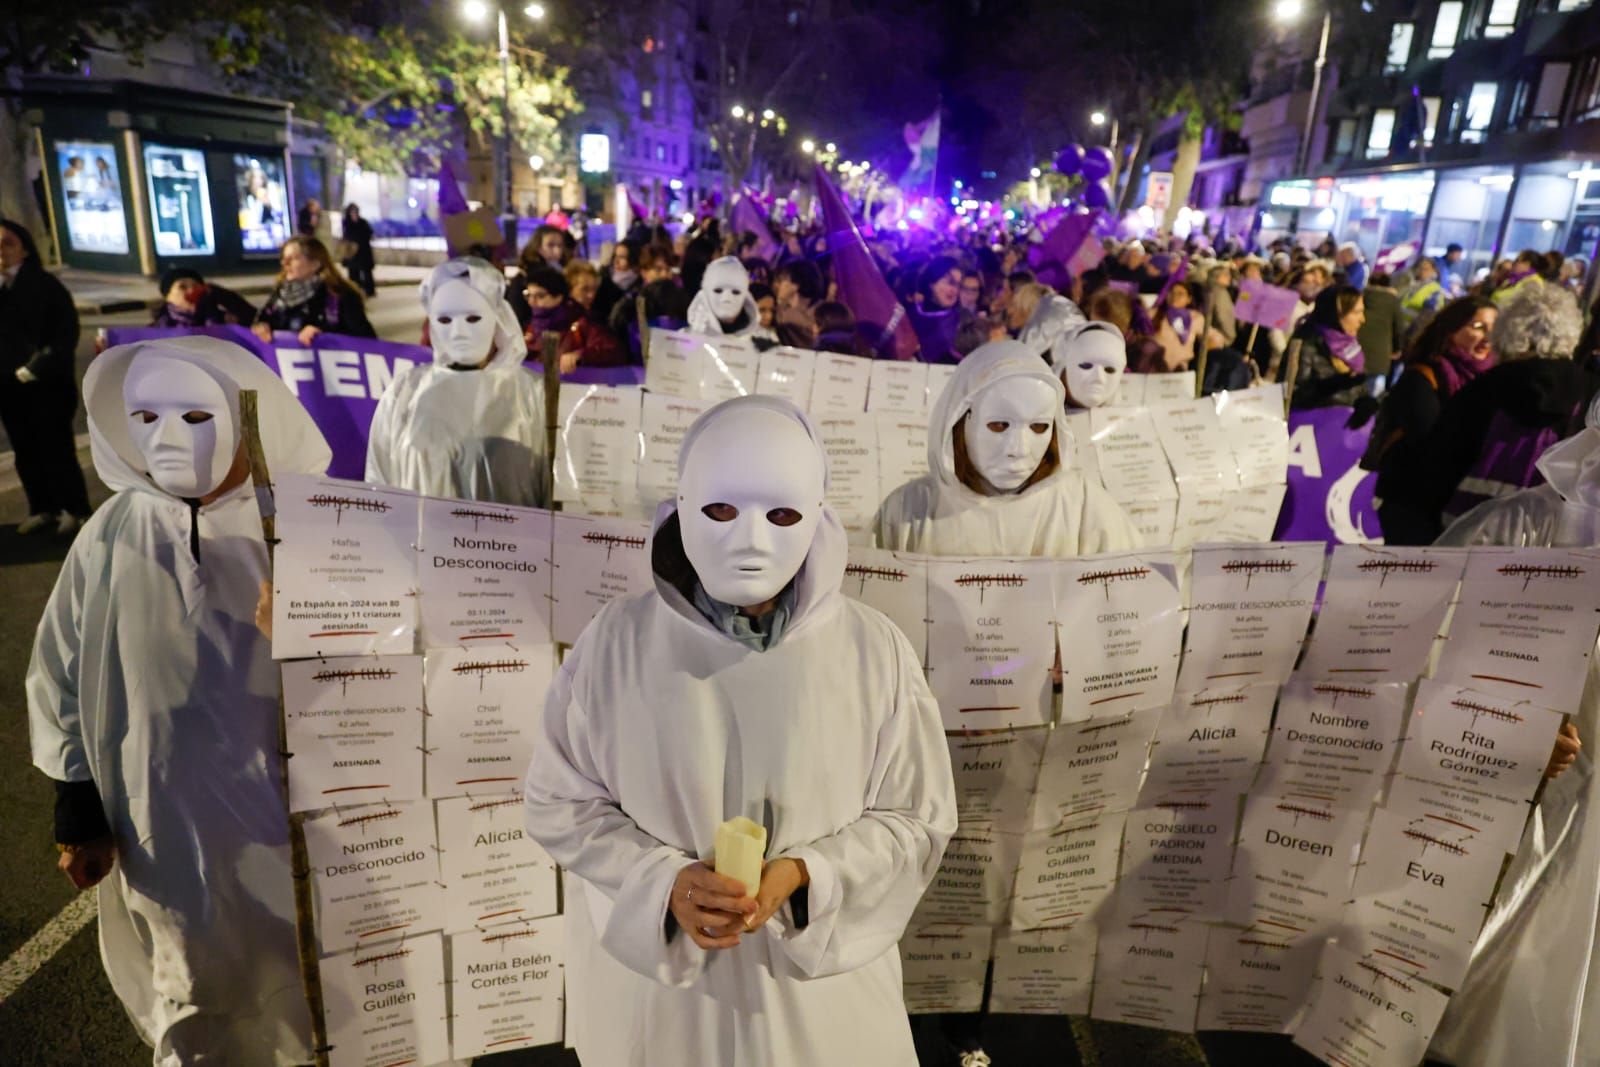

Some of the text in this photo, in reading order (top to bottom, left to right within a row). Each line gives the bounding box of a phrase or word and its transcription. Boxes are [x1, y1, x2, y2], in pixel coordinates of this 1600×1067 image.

[275, 348, 422, 401] FEM
[453, 536, 518, 553] Nombre
[433, 556, 537, 574] Desconocido
[1225, 559, 1292, 574] SOMOS ELLAS
[1361, 559, 1433, 573] SOMOS ELLAS
[1502, 563, 1579, 579] SOMOS ELLAS
[959, 573, 1023, 588] SOMOS ELLAS
[1081, 566, 1147, 586] SOMOS ELLAS
[291, 601, 301, 609] En
[304, 600, 335, 610] España
[350, 600, 370, 608] 2024
[1197, 599, 1306, 610] NOMBRE DESCONOCIDO
[1480, 600, 1509, 609] Mujer
[287, 611, 342, 620] feminicidios
[976, 617, 1002, 626] CLOE
[1096, 611, 1139, 624] CRISTIAN
[321, 621, 369, 630] asesinadas
[1488, 649, 1540, 662] ASESINADA
[970, 678, 1014, 686] ASESINADA
[1084, 671, 1123, 683] VIOLENCIA
[1124, 666, 1152, 677] VICARIA
[1083, 674, 1158, 693] CONTRA LA INFANCIA
[299, 705, 406, 719] Nombre desconocido
[1310, 711, 1370, 730] Nombre
[1188, 726, 1237, 742] Alicia
[1287, 729, 1384, 752] Desconocido
[1461, 730, 1496, 749] Rita
[1076, 739, 1118, 754] Diana
[1067, 751, 1119, 769] Marisol
[1430, 740, 1519, 770] Rodríguez
[333, 759, 381, 768] ASESINADA
[962, 760, 1003, 772] Meri
[1439, 758, 1501, 780] Gómez
[1144, 823, 1217, 834] CONSUELO
[342, 834, 404, 856] Nombre
[474, 827, 524, 848] Alicia
[1265, 828, 1334, 858] Doreen
[1046, 839, 1096, 855] Catalina
[325, 850, 425, 878] Desconocido
[1047, 853, 1090, 868] Guillén
[1152, 855, 1203, 865] MEDINA
[938, 866, 985, 876] Arregui
[1038, 867, 1096, 883] Balbuena
[1405, 860, 1446, 889] Eva
[938, 879, 981, 889] Blasco
[1018, 944, 1055, 954] Diana
[1128, 945, 1174, 959] Amelia
[512, 954, 552, 969] Belén
[1240, 958, 1281, 972] Nadia
[365, 978, 405, 996] Rosa
[471, 969, 549, 990] Cortés Flor
[1334, 974, 1383, 1006] Josefa
[363, 991, 416, 1013] Guillén
